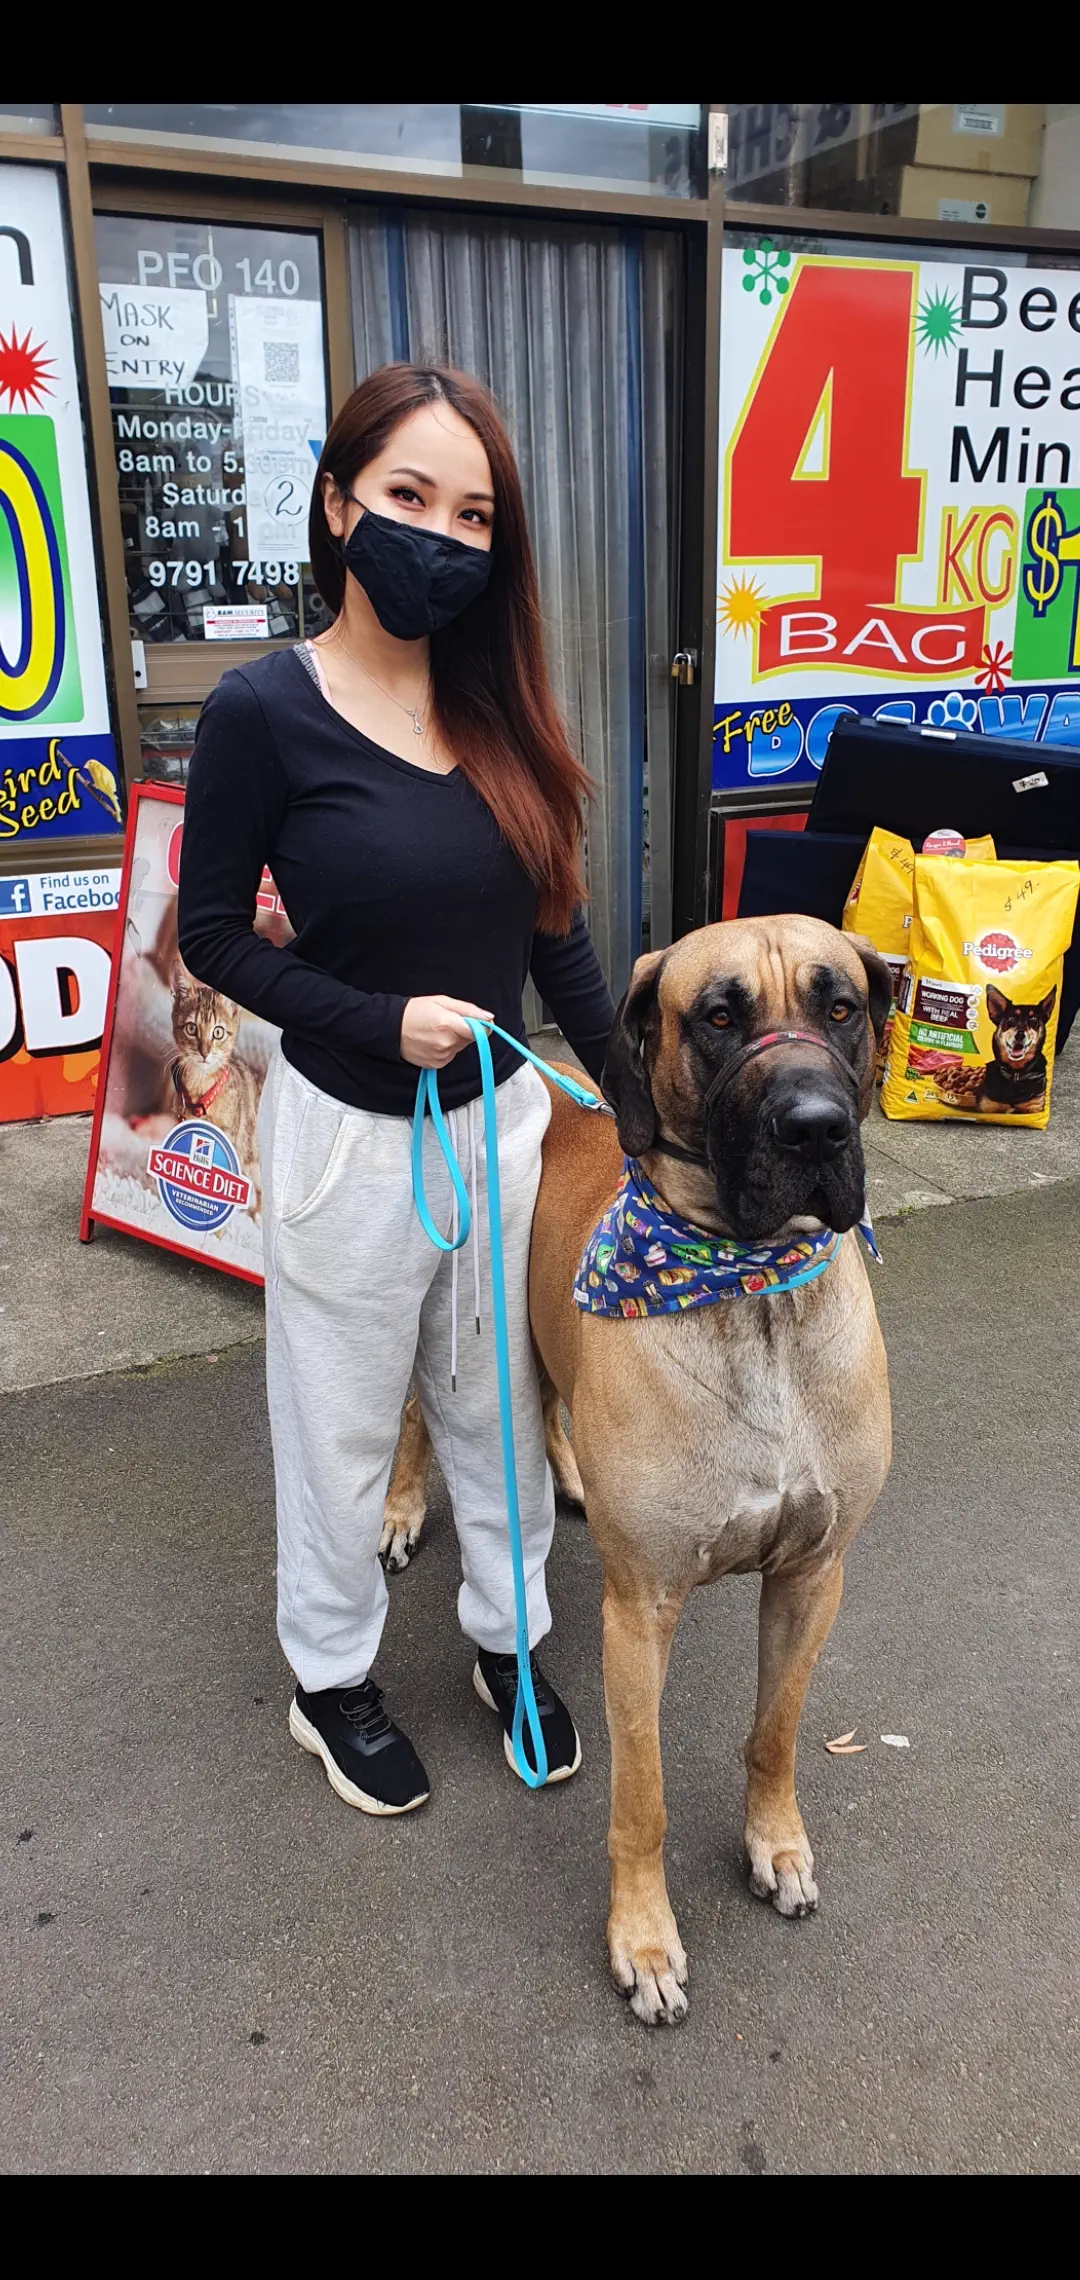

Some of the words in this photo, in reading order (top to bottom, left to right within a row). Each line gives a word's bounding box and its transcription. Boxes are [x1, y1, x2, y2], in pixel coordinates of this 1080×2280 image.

[137, 250, 222, 290] PFO
[236, 257, 300, 295] 140
[100, 292, 174, 330] MASK
[120, 334, 150, 346] ON
[105, 352, 186, 385] ENTRY
[164, 382, 260, 407] HOURS
[119, 449, 175, 472] 8am
[186, 451, 211, 472] to
[949, 425, 1071, 483] Min
[275, 480, 303, 516] 2
[145, 516, 200, 538] 8am
[941, 510, 1014, 604] KG
[149, 561, 217, 587] 9791
[231, 561, 300, 586] 7498
[780, 612, 966, 666] BAG
[712, 701, 794, 753] Free
[0, 738, 62, 803] ird
[0, 767, 80, 838] Seed
[40, 875, 69, 889] Find
[74, 875, 89, 886] us
[93, 874, 109, 885] on
[962, 942, 1033, 959] Pedigree
[921, 990, 949, 1003] WORKING
[949, 996, 965, 1005] DOG
[922, 1005, 940, 1015] WITH
[941, 1010, 959, 1019] REAL
[930, 1014, 949, 1023] BEEF
[153, 1153, 211, 1189] SCIENCE
[212, 1173, 245, 1199] DIET
[171, 1189, 219, 1212] VETERINARIAN
[175, 1198, 214, 1216] RECOMMENDED
